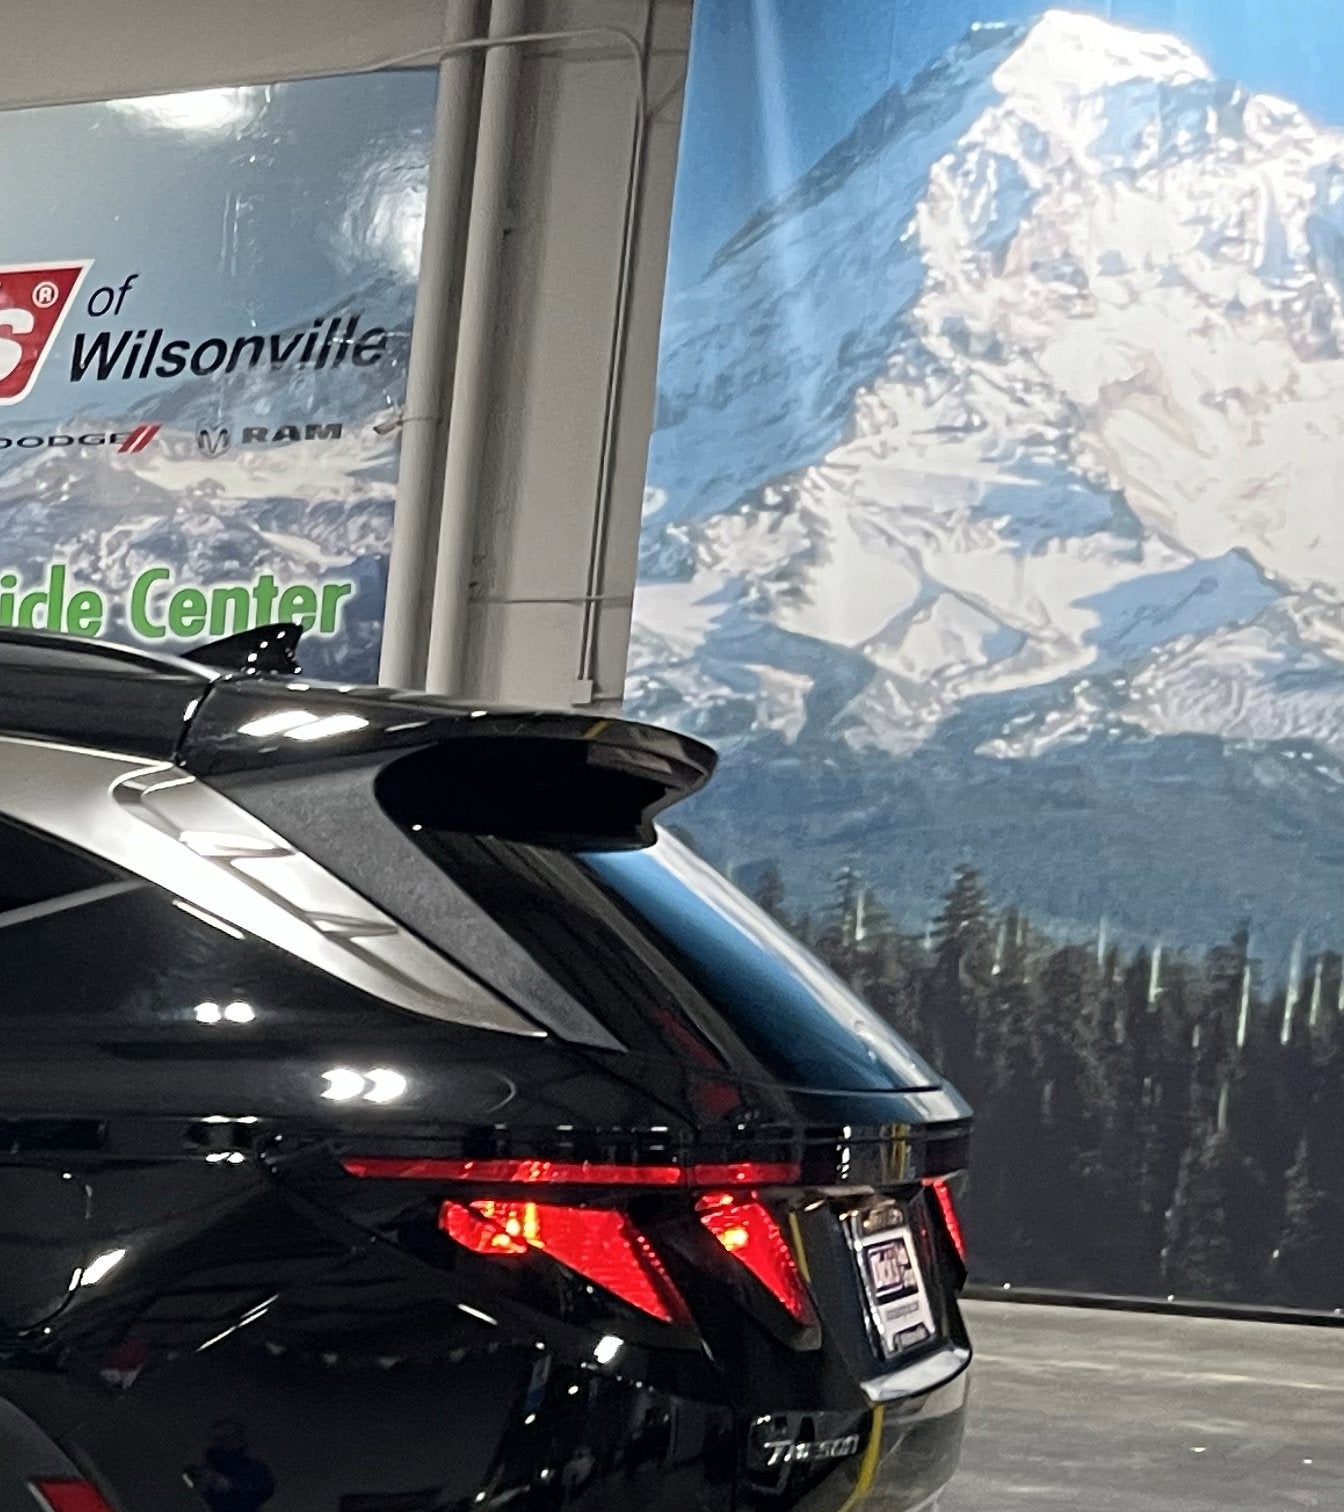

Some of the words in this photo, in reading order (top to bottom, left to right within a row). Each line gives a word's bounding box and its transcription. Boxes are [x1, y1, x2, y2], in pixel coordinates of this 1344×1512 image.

[87, 274, 139, 318] of
[69, 313, 387, 382] Wilsonville
[240, 423, 343, 444] RAM
[130, 567, 352, 638] Center
